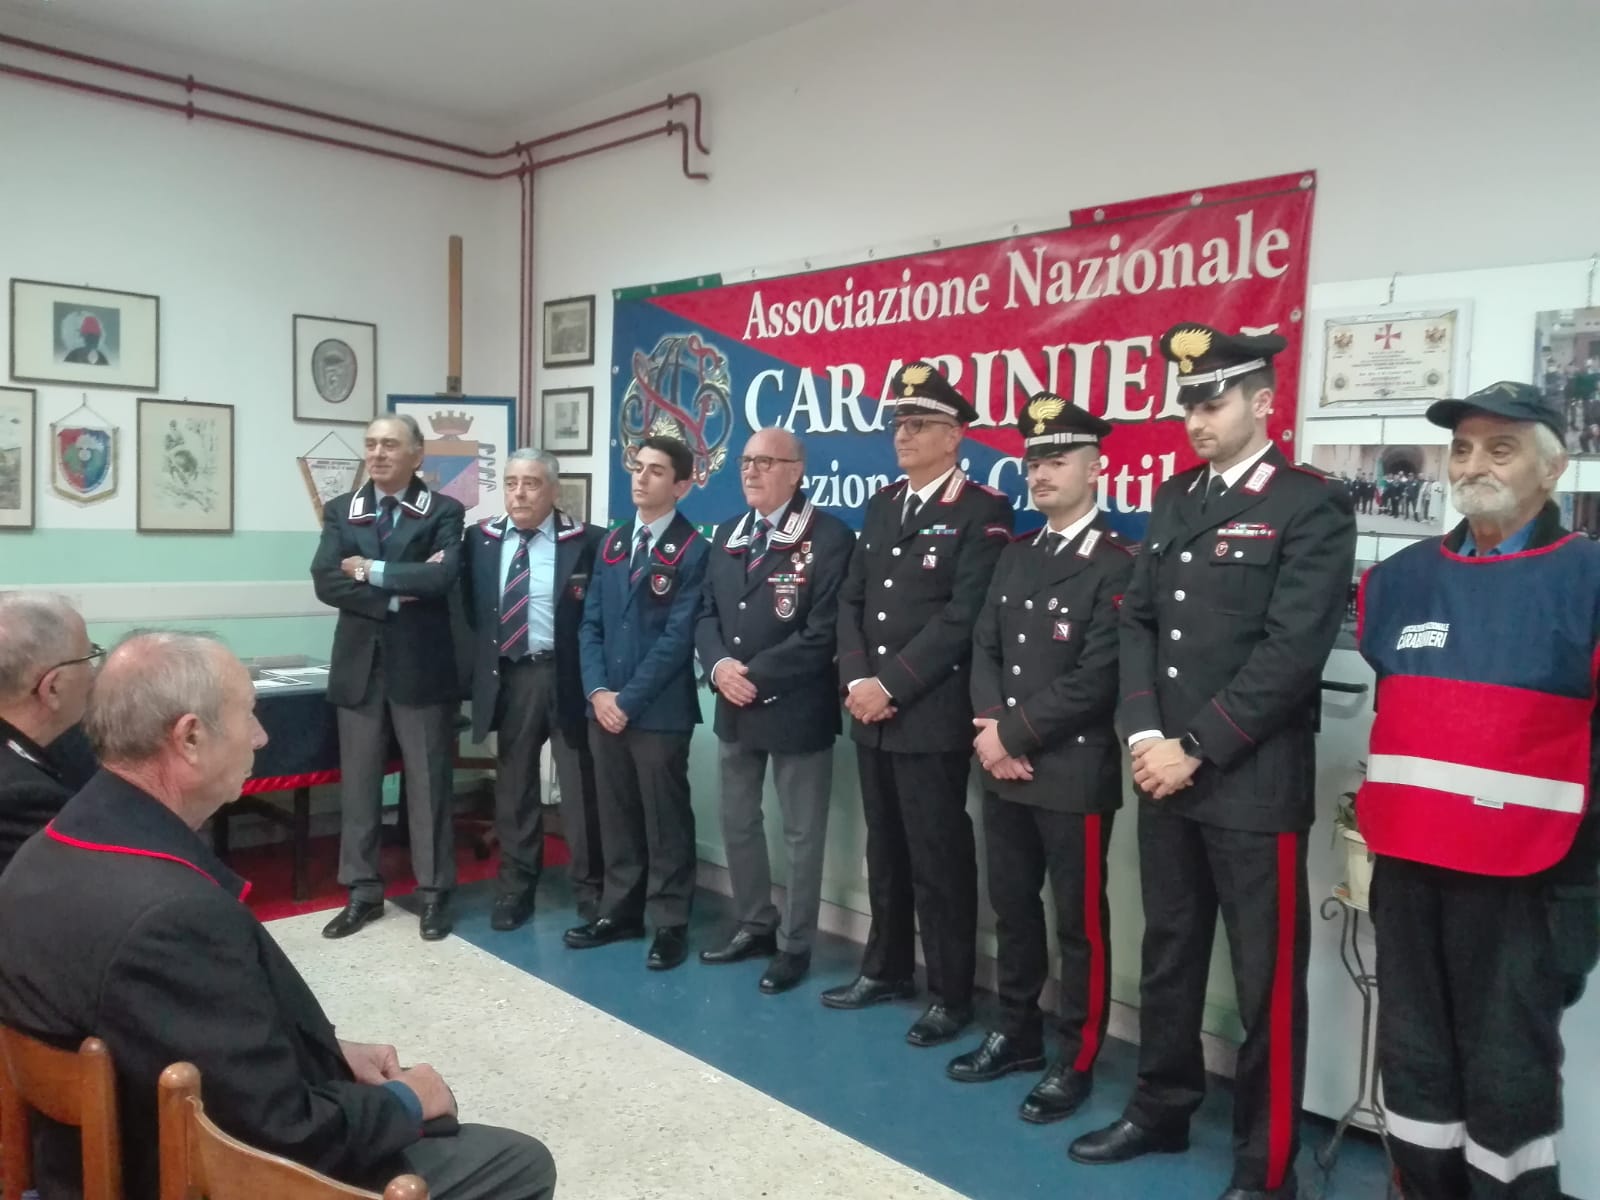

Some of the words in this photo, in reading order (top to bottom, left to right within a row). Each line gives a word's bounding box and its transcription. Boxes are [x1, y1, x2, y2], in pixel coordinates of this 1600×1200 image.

[742, 268, 990, 341] Associazione
[1003, 208, 1290, 310] Nazionale
[744, 322, 1280, 435] CARAINIE
